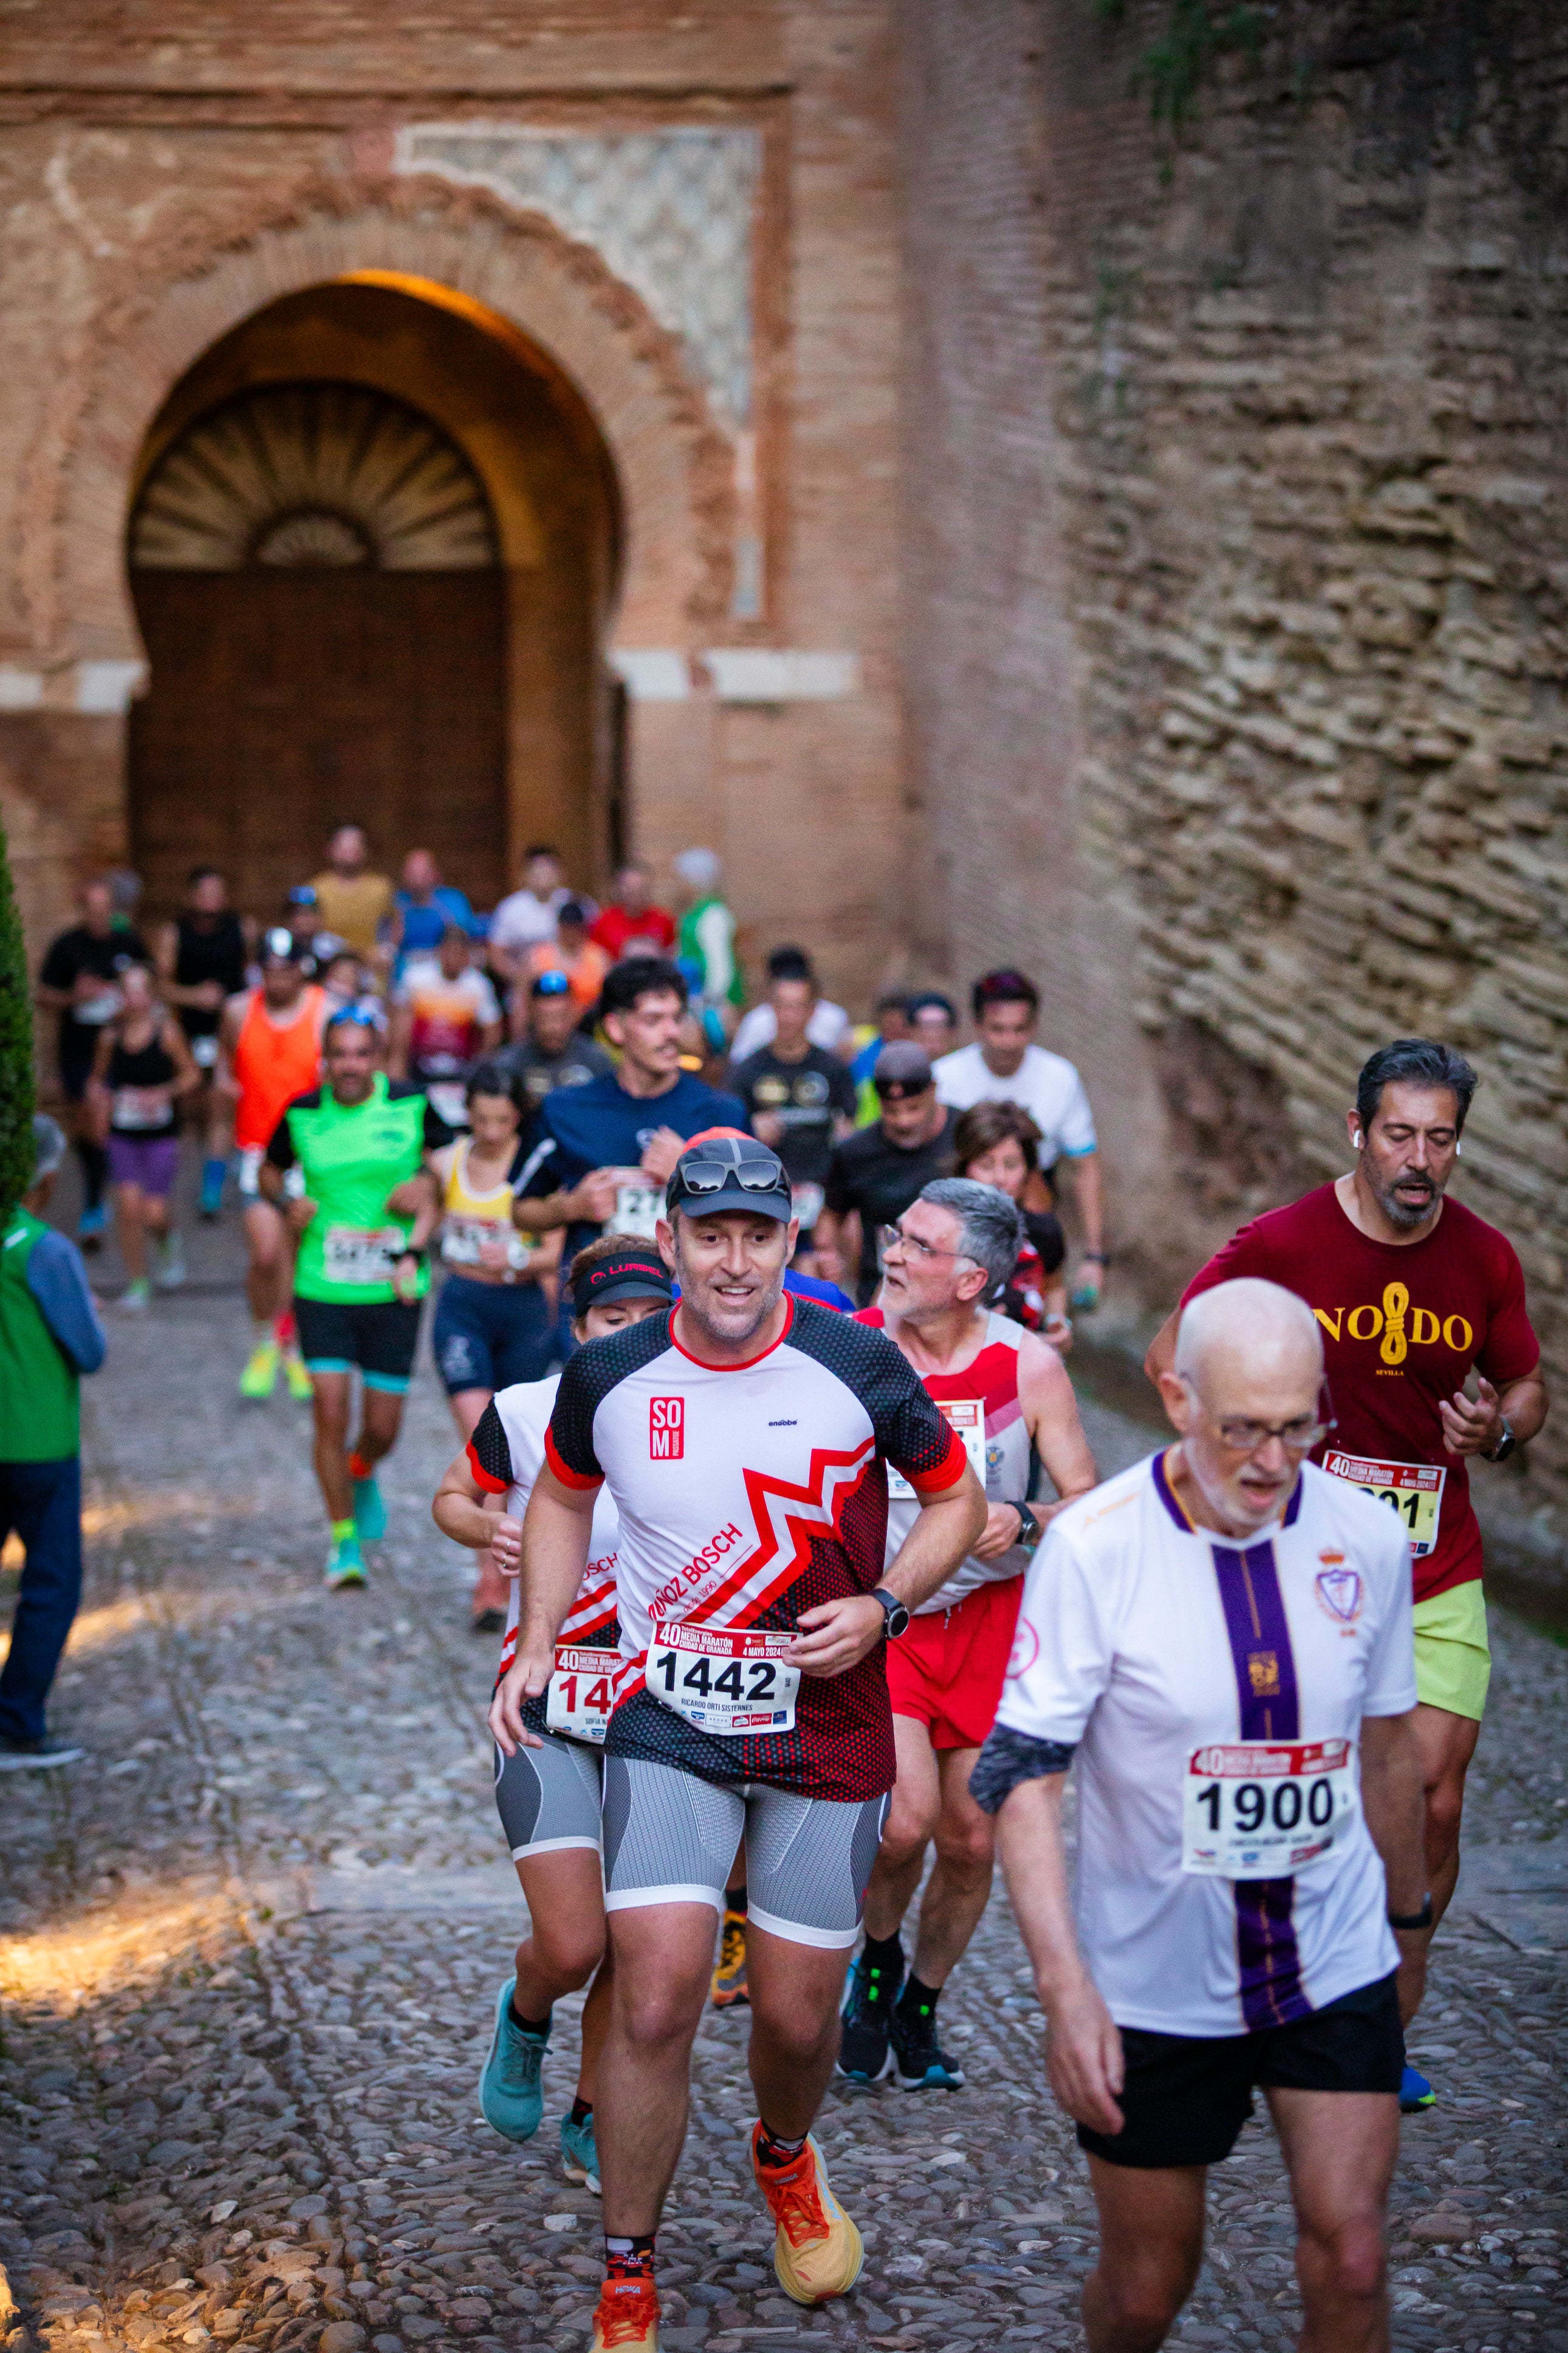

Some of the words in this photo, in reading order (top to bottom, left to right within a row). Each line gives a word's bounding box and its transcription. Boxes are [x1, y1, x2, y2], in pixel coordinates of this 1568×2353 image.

[609, 1263, 663, 1279] LURBEL
[652, 1400, 681, 1428] SO
[652, 1430, 669, 1457] M
[1330, 1457, 1351, 1477] 40
[682, 1522, 743, 1585] BOSCH
[699, 1580, 717, 1598] 1990
[659, 1623, 681, 1646] 40
[680, 1632, 700, 1643] MEDIA
[701, 1637, 733, 1648] MARATÓN
[679, 1640, 698, 1651] CIUDAD
[699, 1644, 705, 1652] DE
[706, 1646, 732, 1655] GRANADA
[743, 1647, 747, 1656] 4
[748, 1647, 764, 1657] MAYO
[765, 1647, 781, 1657] 2024
[558, 1650, 579, 1671] 40
[657, 1651, 776, 1700] 1442
[560, 1675, 611, 1714] 14
[681, 1699, 706, 1709] RICARDO
[721, 1703, 753, 1712] SISTERNES
[1197, 1779, 1333, 1832] 1900
[615, 2286, 641, 2294] HOKA
